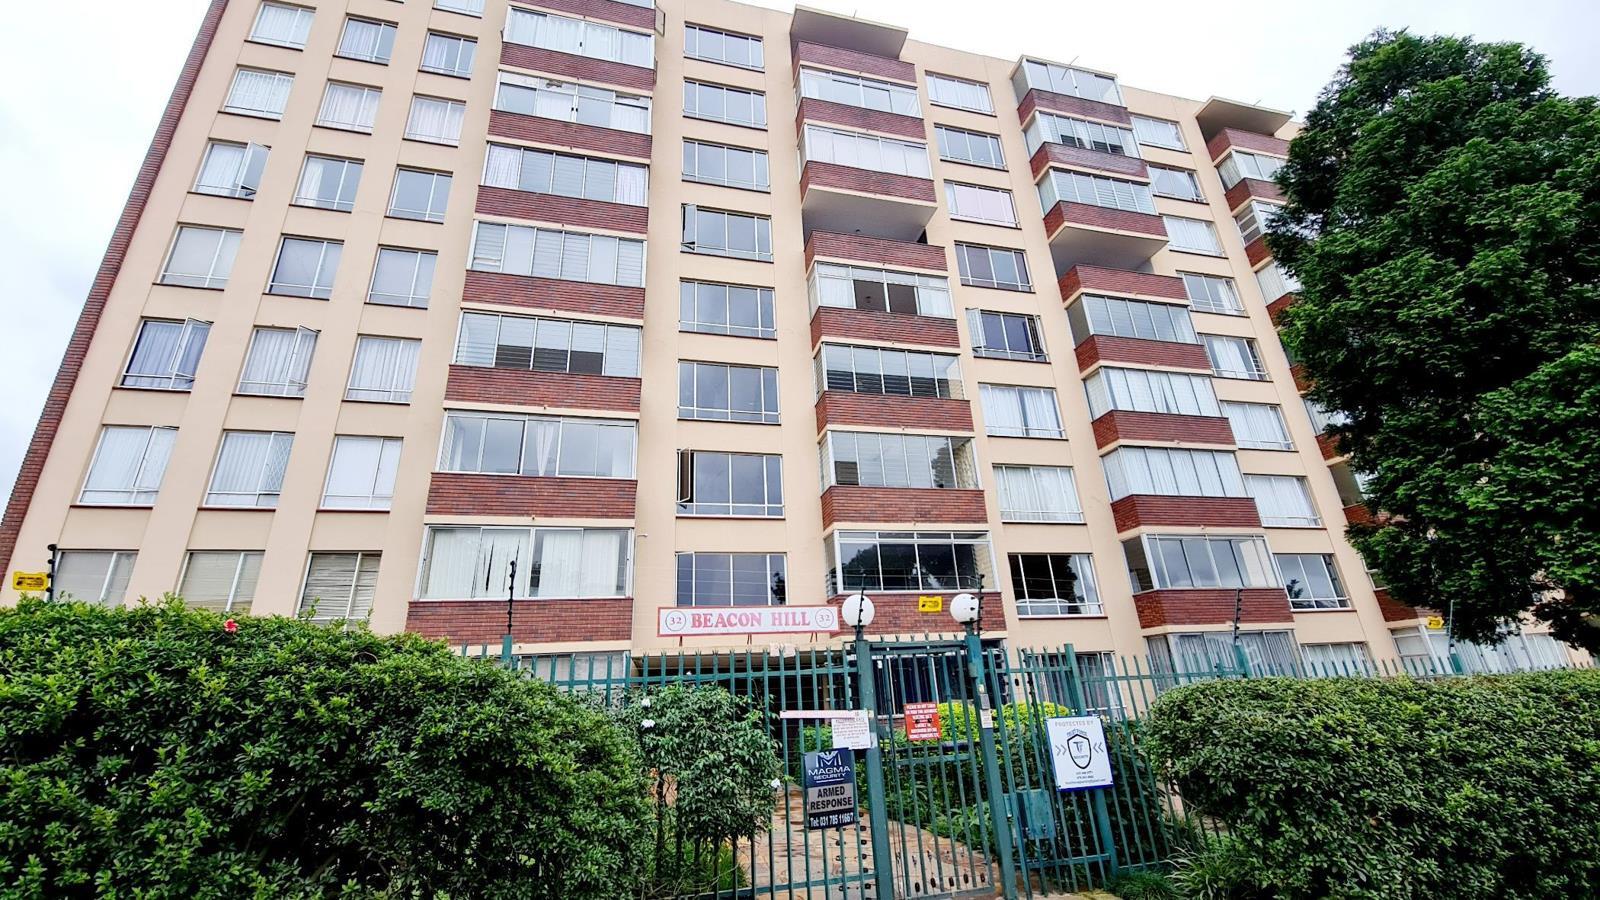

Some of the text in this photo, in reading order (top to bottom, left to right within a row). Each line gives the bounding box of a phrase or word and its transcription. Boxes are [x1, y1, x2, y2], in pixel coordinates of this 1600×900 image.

[670, 611, 831, 629] 32 BEACON HILL 32
[808, 766, 851, 776] MAGMA
[813, 772, 847, 781] SECURITY
[817, 785, 846, 799] ARMED
[810, 796, 853, 811] RESPONSE
[820, 815, 829, 826] 031
